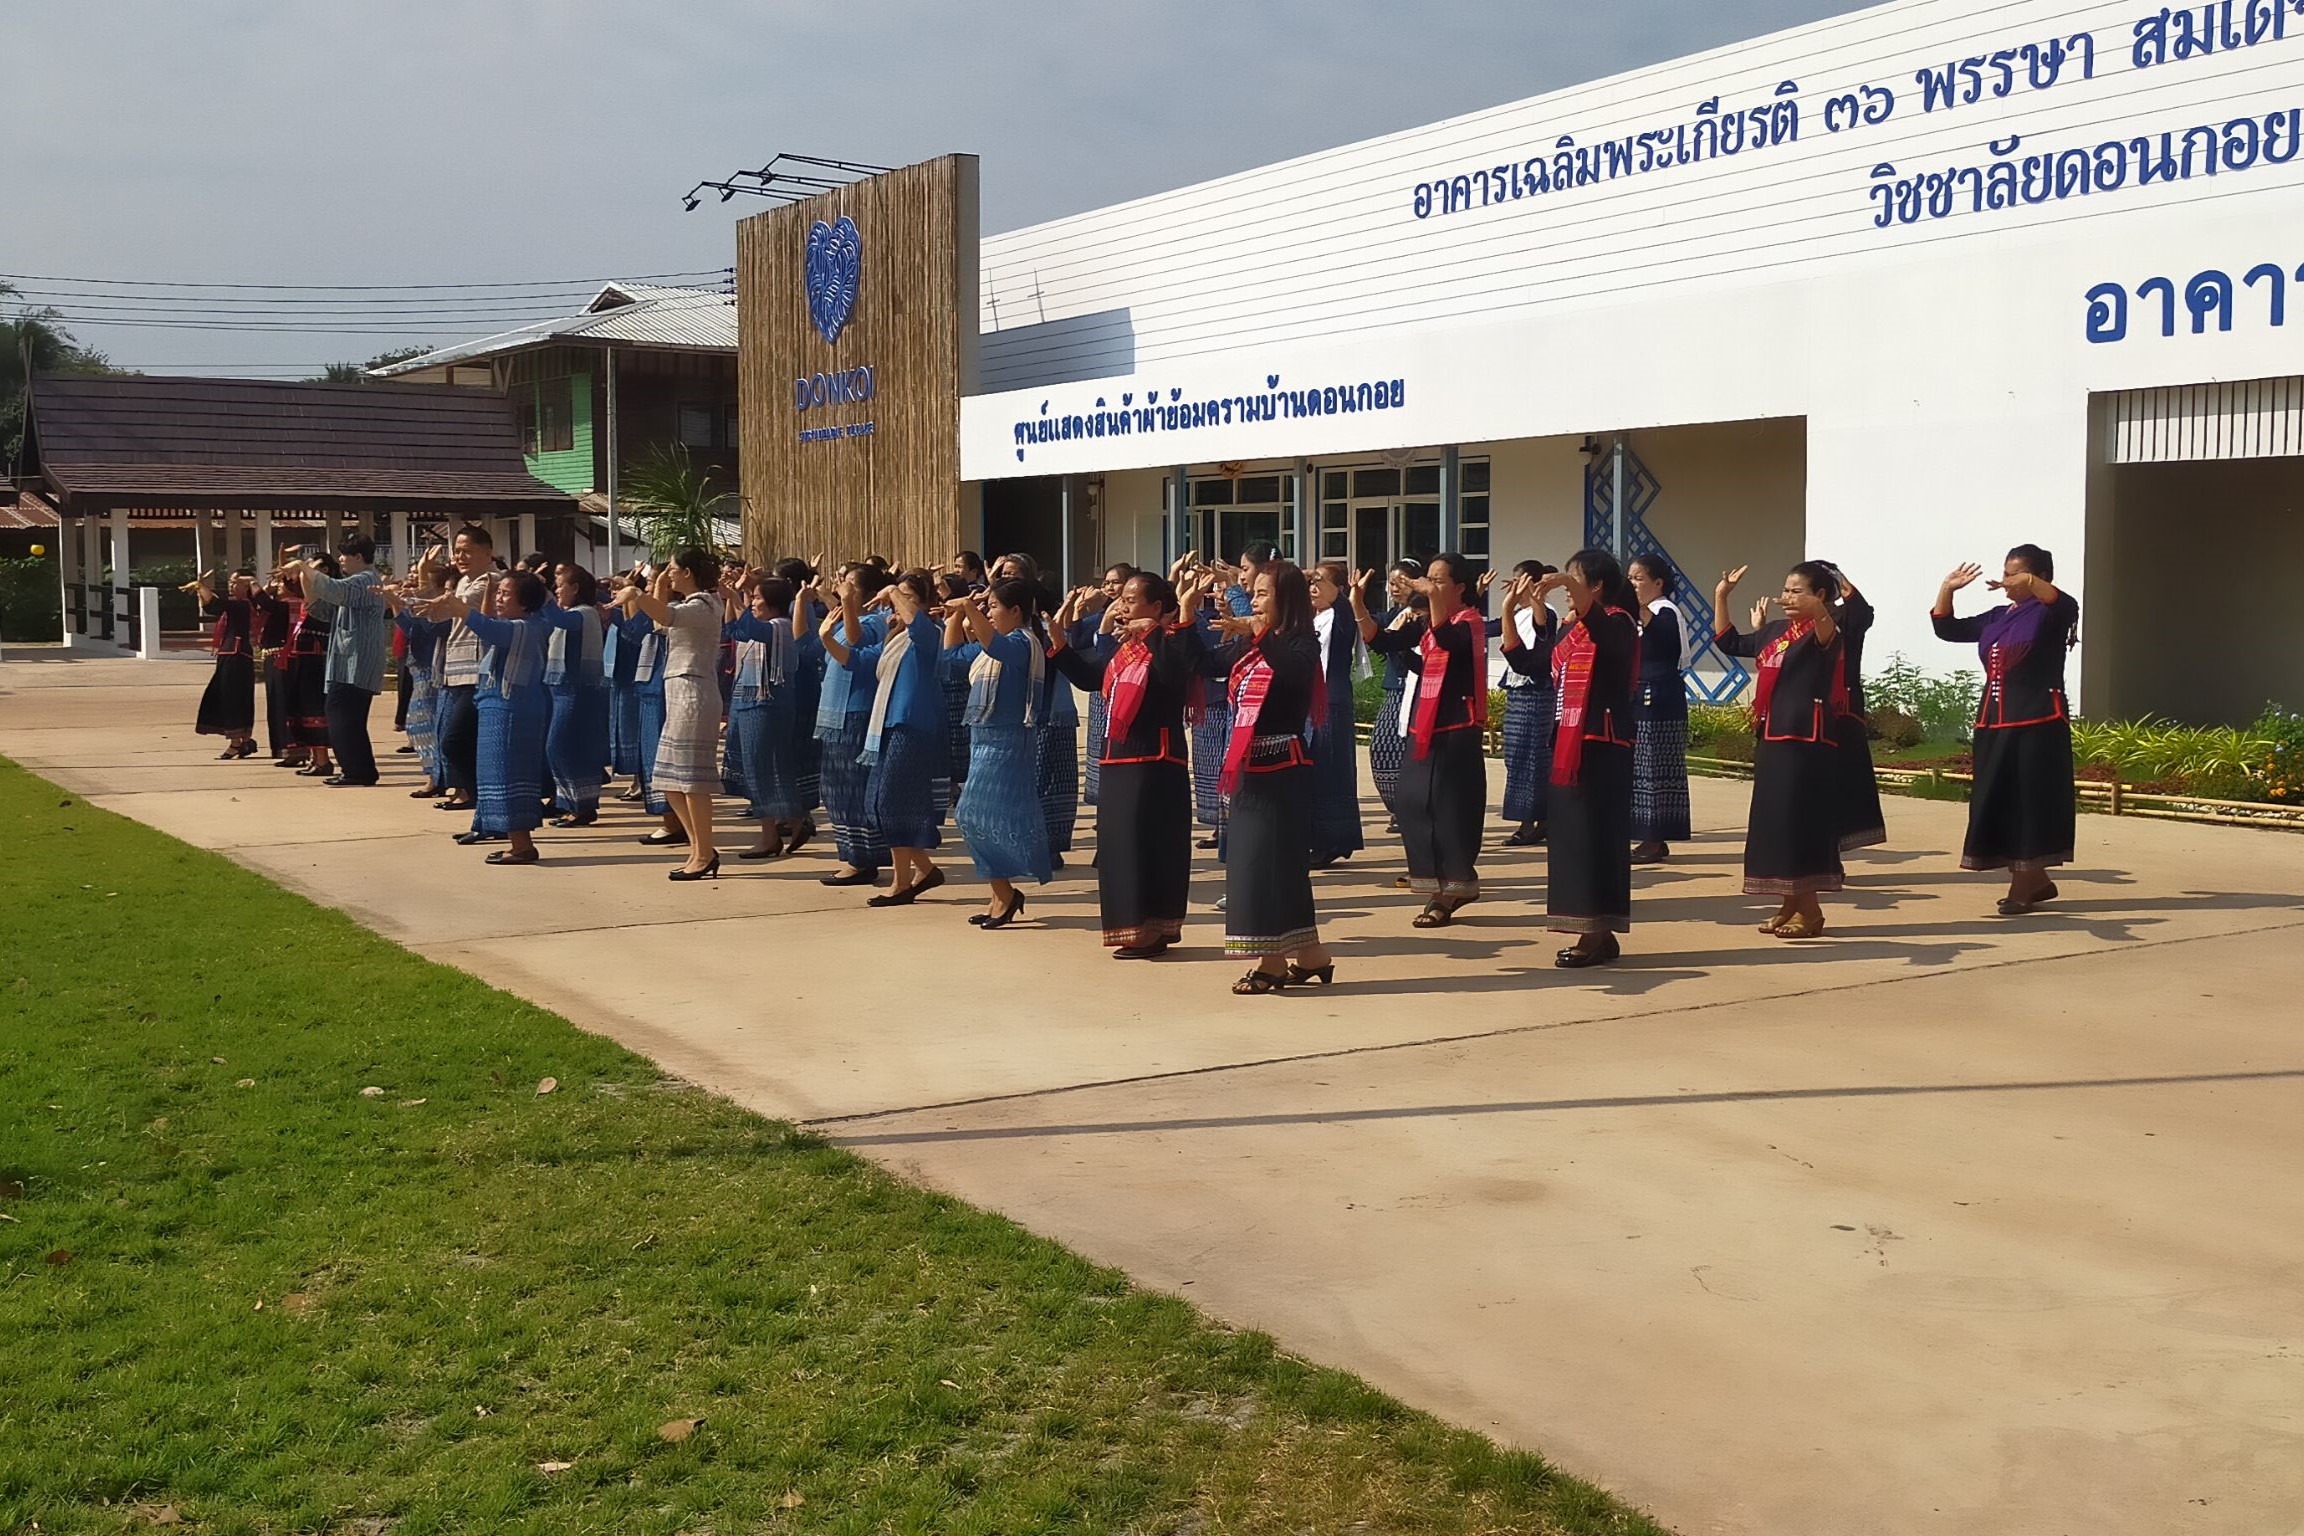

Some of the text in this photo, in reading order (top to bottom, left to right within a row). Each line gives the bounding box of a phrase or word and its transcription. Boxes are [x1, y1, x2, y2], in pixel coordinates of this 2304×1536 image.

[1413, 0, 2304, 219] อาคารเฉลิมพระเกียรติ ๓๖ พรรษา สมเด
[1869, 107, 2302, 229] วิชชาลัยดอนกอย
[2085, 262, 2304, 344] อาคา
[795, 365, 875, 411] DONKOI
[1013, 374, 1405, 462] ศูนย์แสดงสินค้าผ้าย้อมครามบ้านดอนกอย
